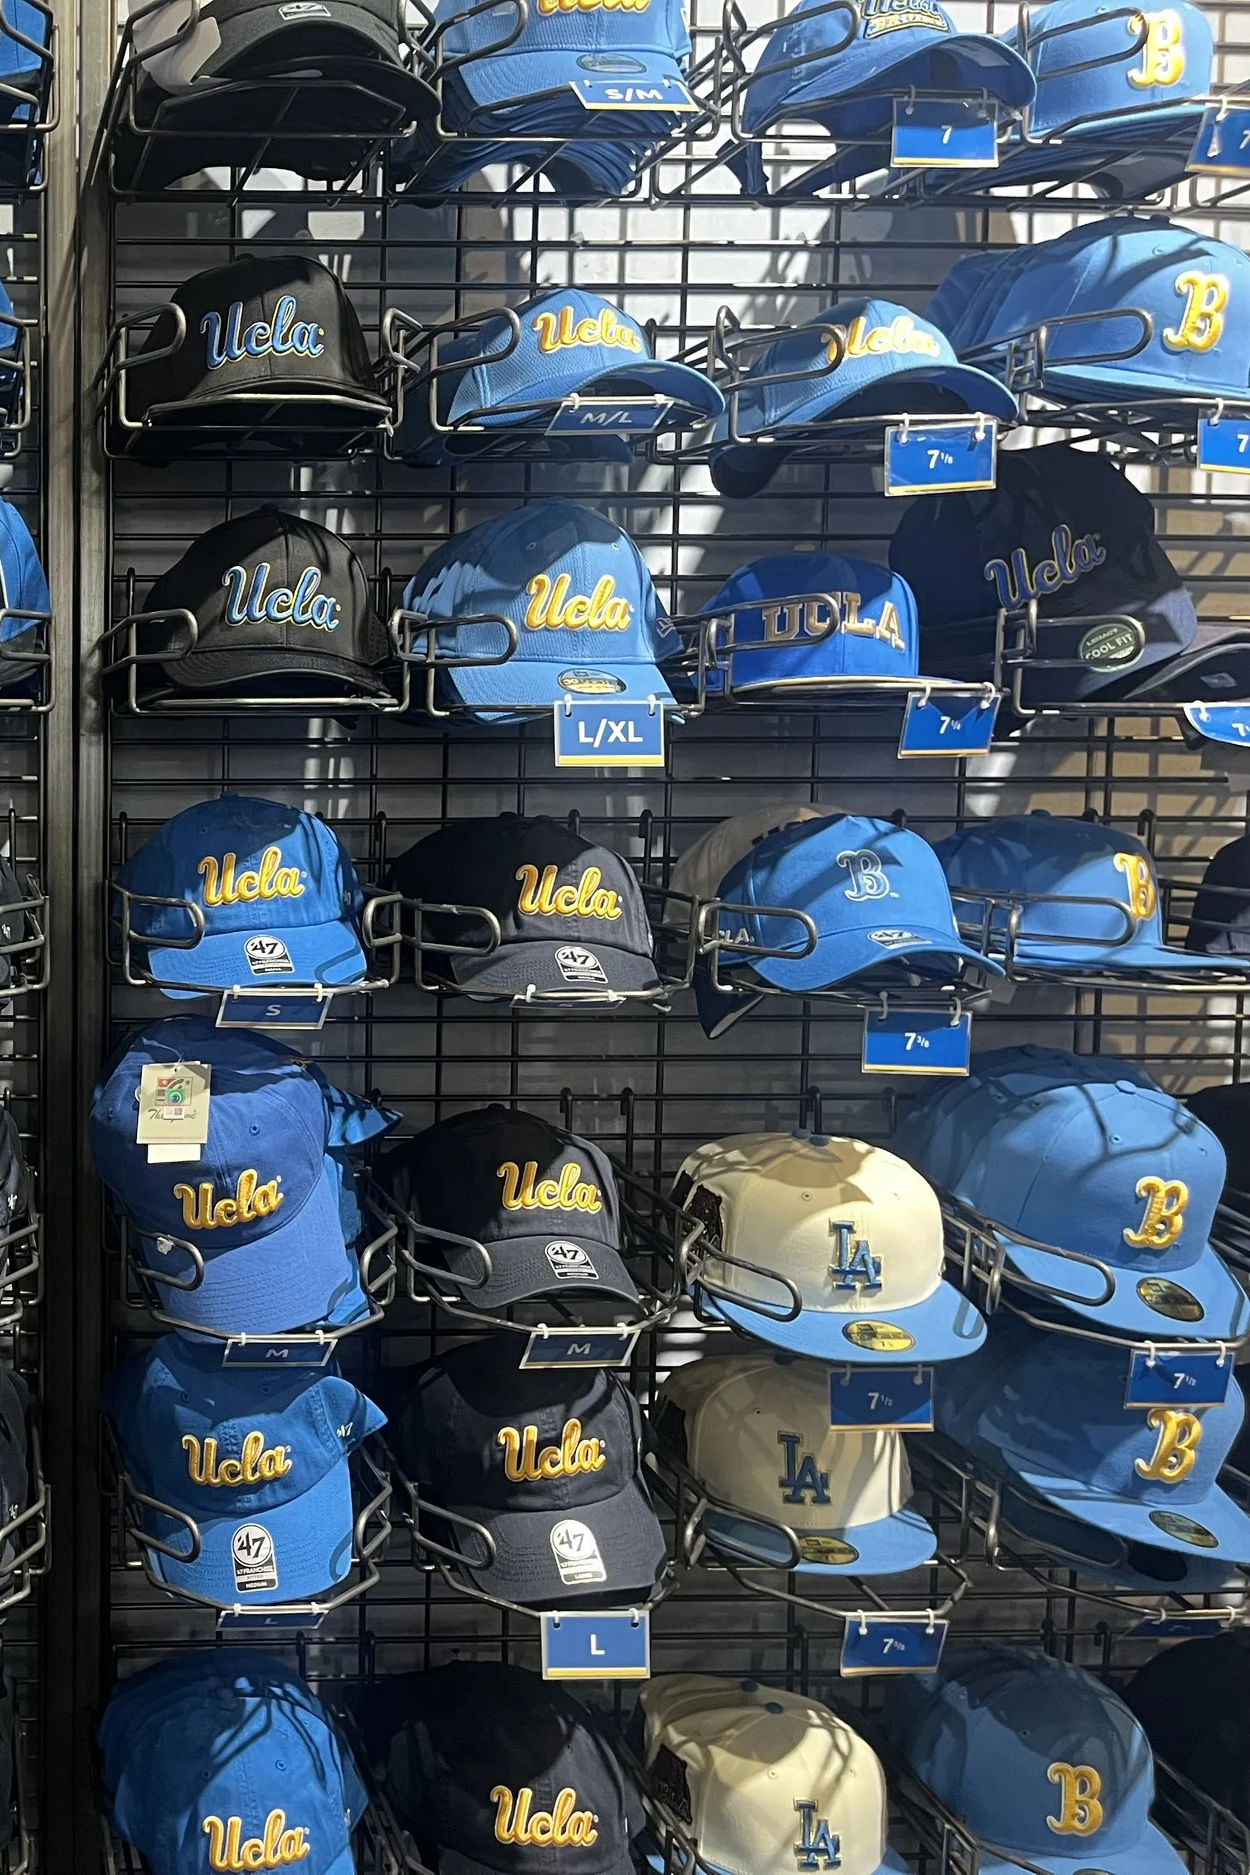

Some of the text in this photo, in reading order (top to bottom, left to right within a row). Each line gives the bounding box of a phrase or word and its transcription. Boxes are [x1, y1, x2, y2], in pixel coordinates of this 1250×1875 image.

[1127, 10, 1186, 88] B
[603, 86, 665, 103] S/M
[941, 125, 953, 144] 7
[200, 295, 325, 370] Ucla
[532, 305, 644, 354] Ucla
[1163, 270, 1230, 353] B
[580, 411, 633, 426] M/L
[221, 562, 342, 632] Ucla
[984, 524, 1107, 610] Ucla
[525, 572, 634, 633] Ucla
[762, 592, 906, 653] UCLA
[1116, 632, 1134, 647] FIT
[578, 720, 644, 749] L/XL
[197, 846, 306, 907] Ucla
[515, 864, 624, 920] Ucla
[836, 849, 890, 902] B
[1114, 852, 1157, 920] B
[266, 1004, 281, 1017] S
[174, 1168, 283, 1230] Ucla
[497, 1160, 603, 1214] Ucla
[1122, 1176, 1192, 1250] B
[829, 1220, 883, 1290] LA
[265, 1348, 290, 1358] M
[566, 1342, 592, 1355] M
[182, 1431, 291, 1487] Ucla
[498, 1418, 605, 1483] Ucla
[778, 1430, 831, 1504] LA
[1135, 1408, 1202, 1483] B
[590, 1635, 605, 1656] L
[491, 1785, 598, 1848] Ucla
[1046, 1762, 1101, 1837] B
[203, 1808, 310, 1874] Ucla
[792, 1798, 841, 1870] LA
